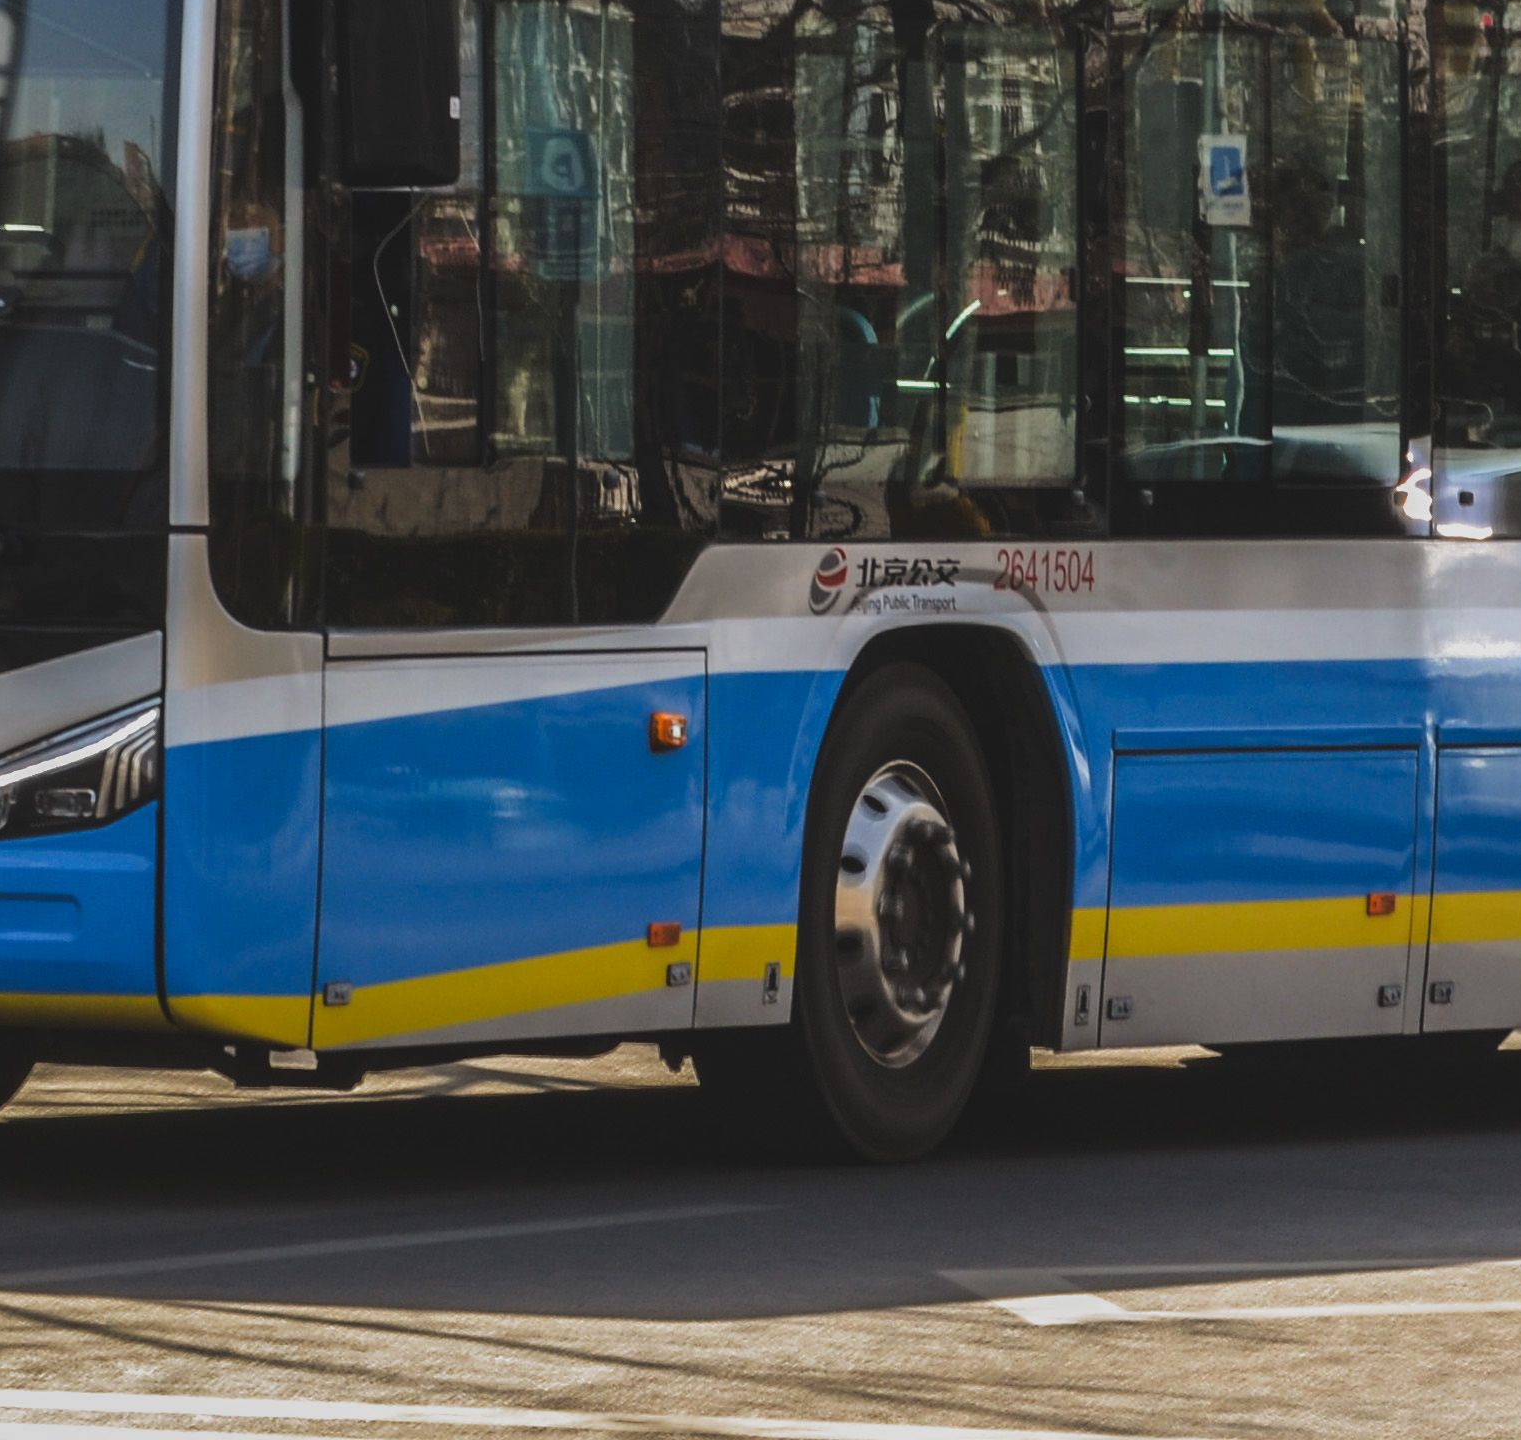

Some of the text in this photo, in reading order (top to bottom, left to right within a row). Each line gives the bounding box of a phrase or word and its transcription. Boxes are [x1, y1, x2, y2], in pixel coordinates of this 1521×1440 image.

[855, 557, 961, 588] 北京公交
[993, 549, 1095, 593] 2641504
[851, 593, 957, 616] ejing Public Transport
